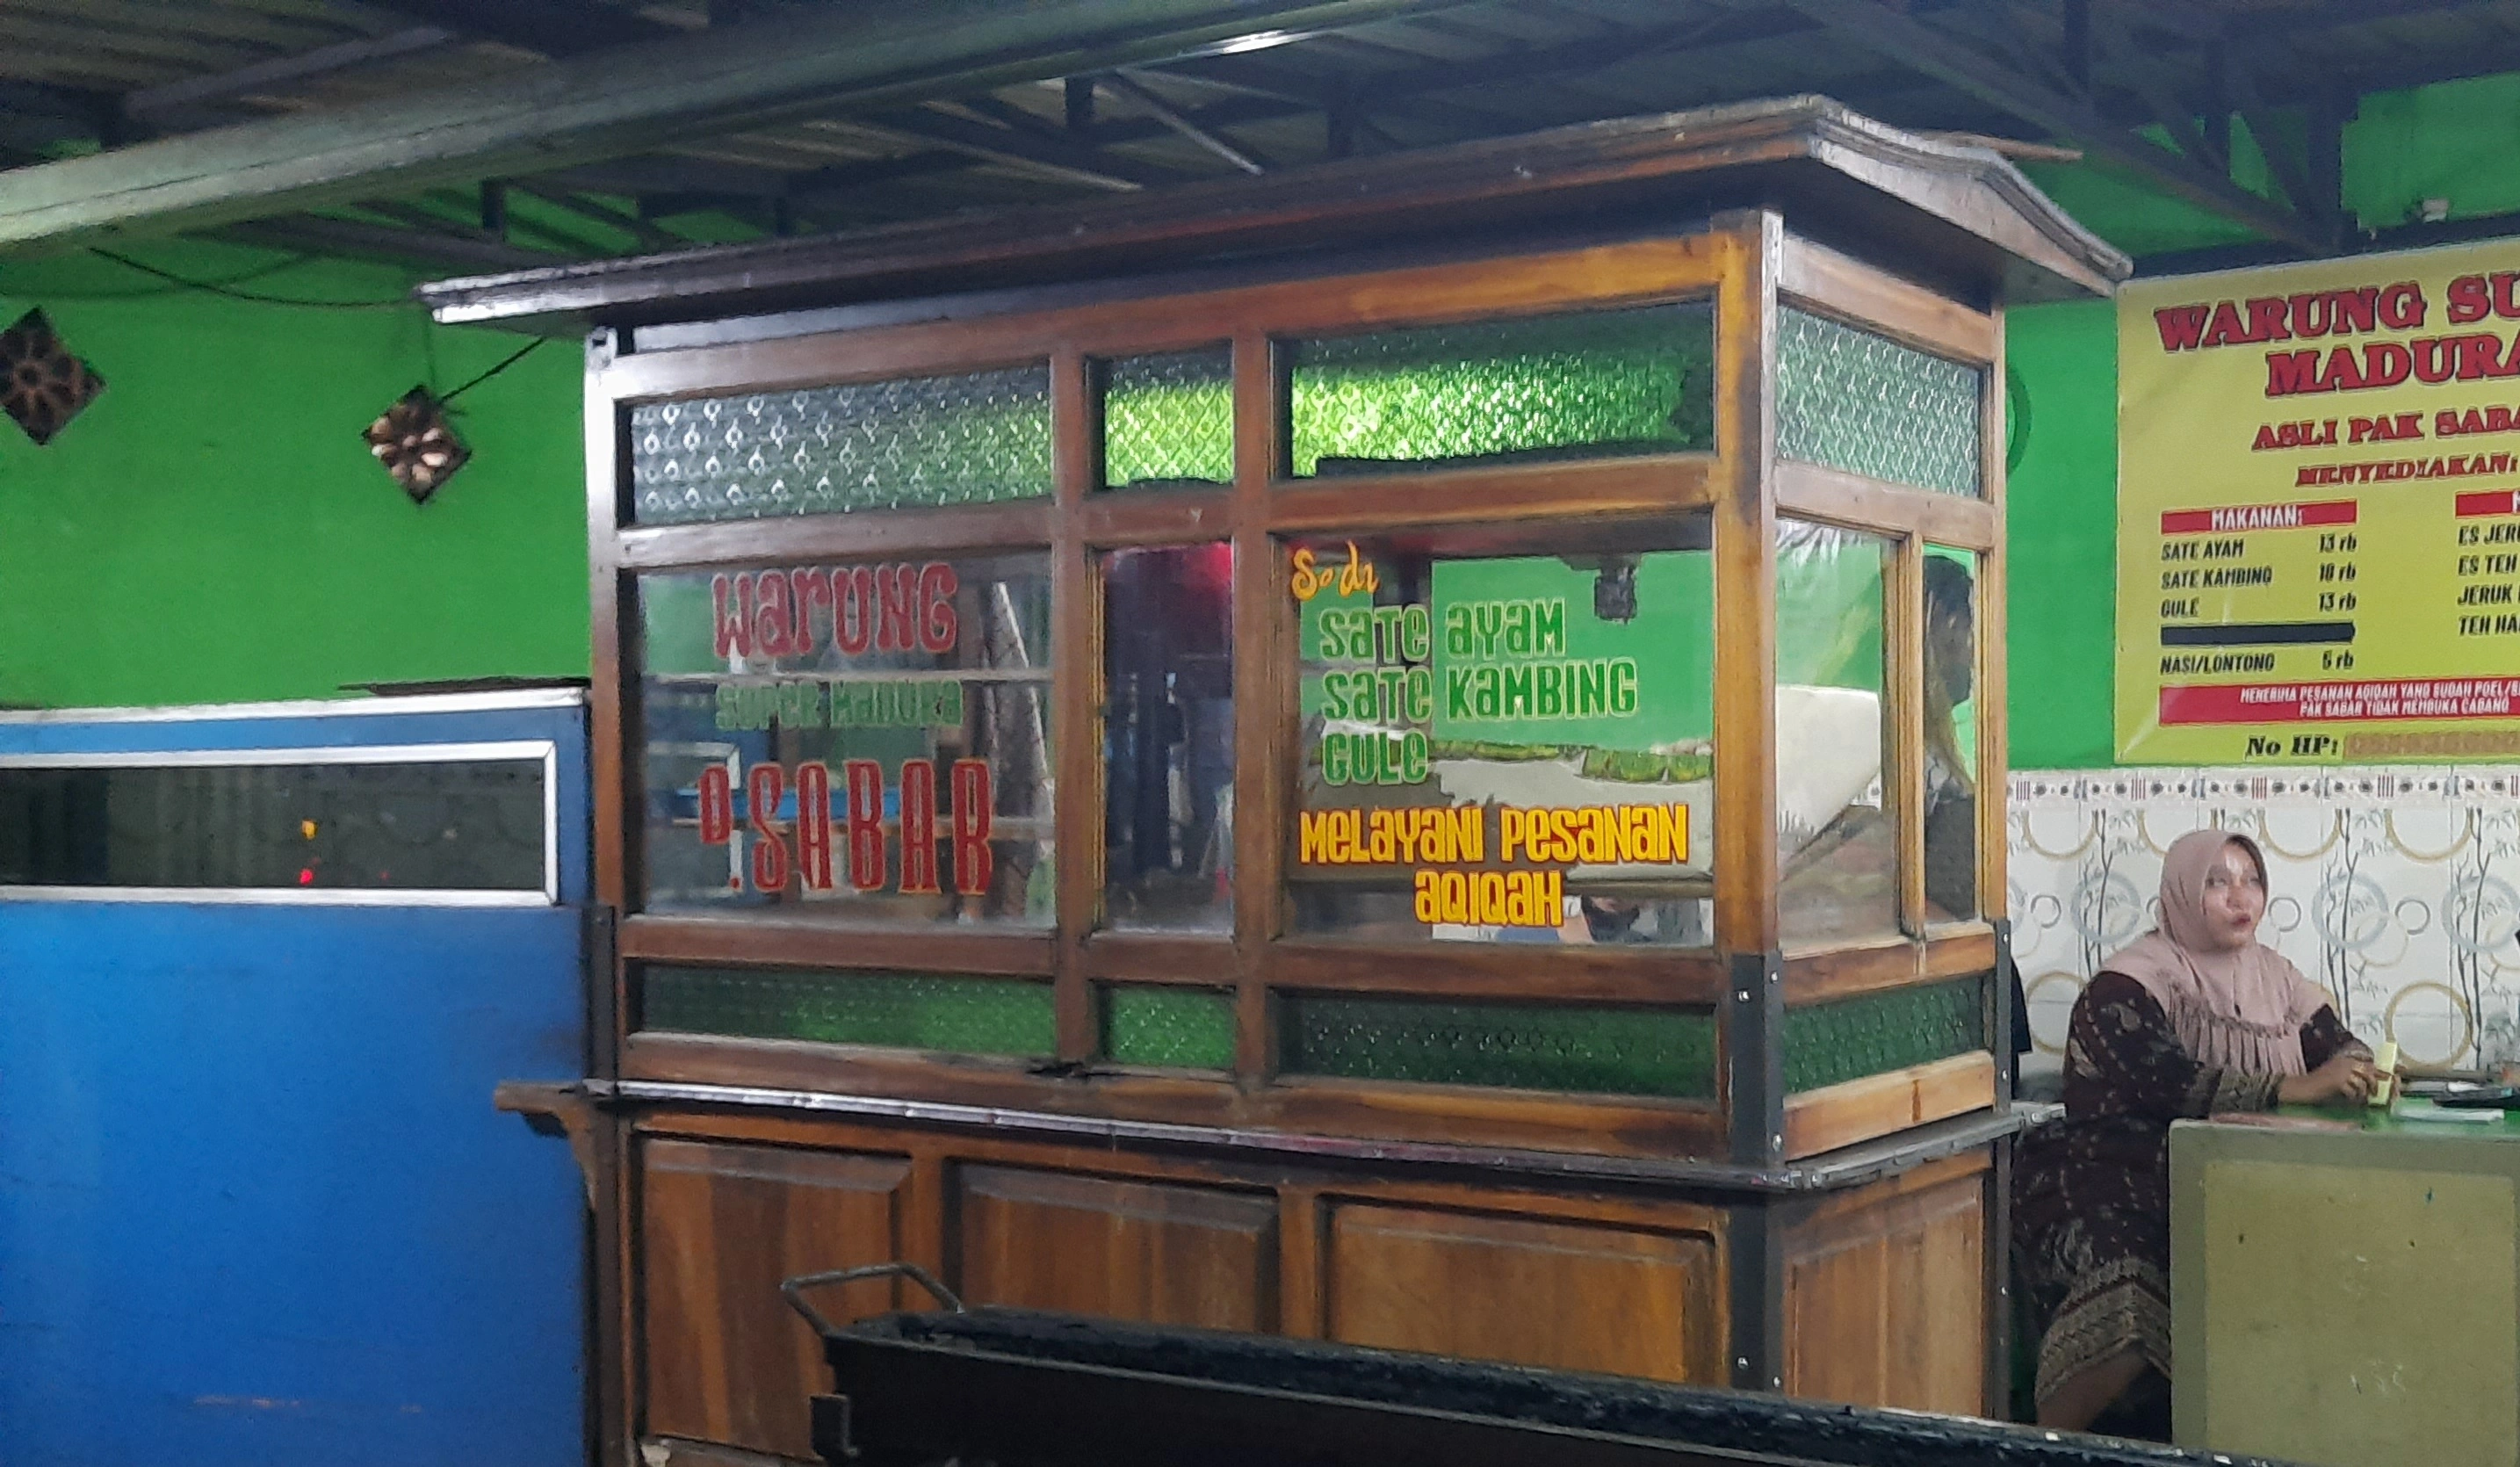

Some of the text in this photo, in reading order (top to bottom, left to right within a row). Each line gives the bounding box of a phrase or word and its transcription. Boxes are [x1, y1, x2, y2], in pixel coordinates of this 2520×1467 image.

[2154, 281, 2427, 352] WARUNG
[2251, 420, 2337, 452] ASLI
[2348, 410, 2424, 444] PAK
[2295, 452, 2518, 487] MENYEDIAKAN:
[2212, 504, 2302, 531] MAKANAN:
[2320, 532, 2357, 553] 13 rb
[2459, 526, 2480, 546] ES
[2162, 538, 2244, 560] SATE AYAM
[2339, 562, 2356, 581] rb
[2459, 553, 2517, 575] ES TEH
[2162, 565, 2272, 589] SATE KAMBING
[2320, 593, 2357, 611] 13 rb
[2458, 584, 2513, 605] JERUK
[2161, 597, 2199, 618] GULE
[2459, 613, 2520, 636] TEH HA
[2160, 652, 2275, 676] NASI/LONTONG
[2336, 651, 2353, 668] rb
[2300, 684, 2353, 701] PESANAN
[2245, 734, 2338, 756] No HP:
